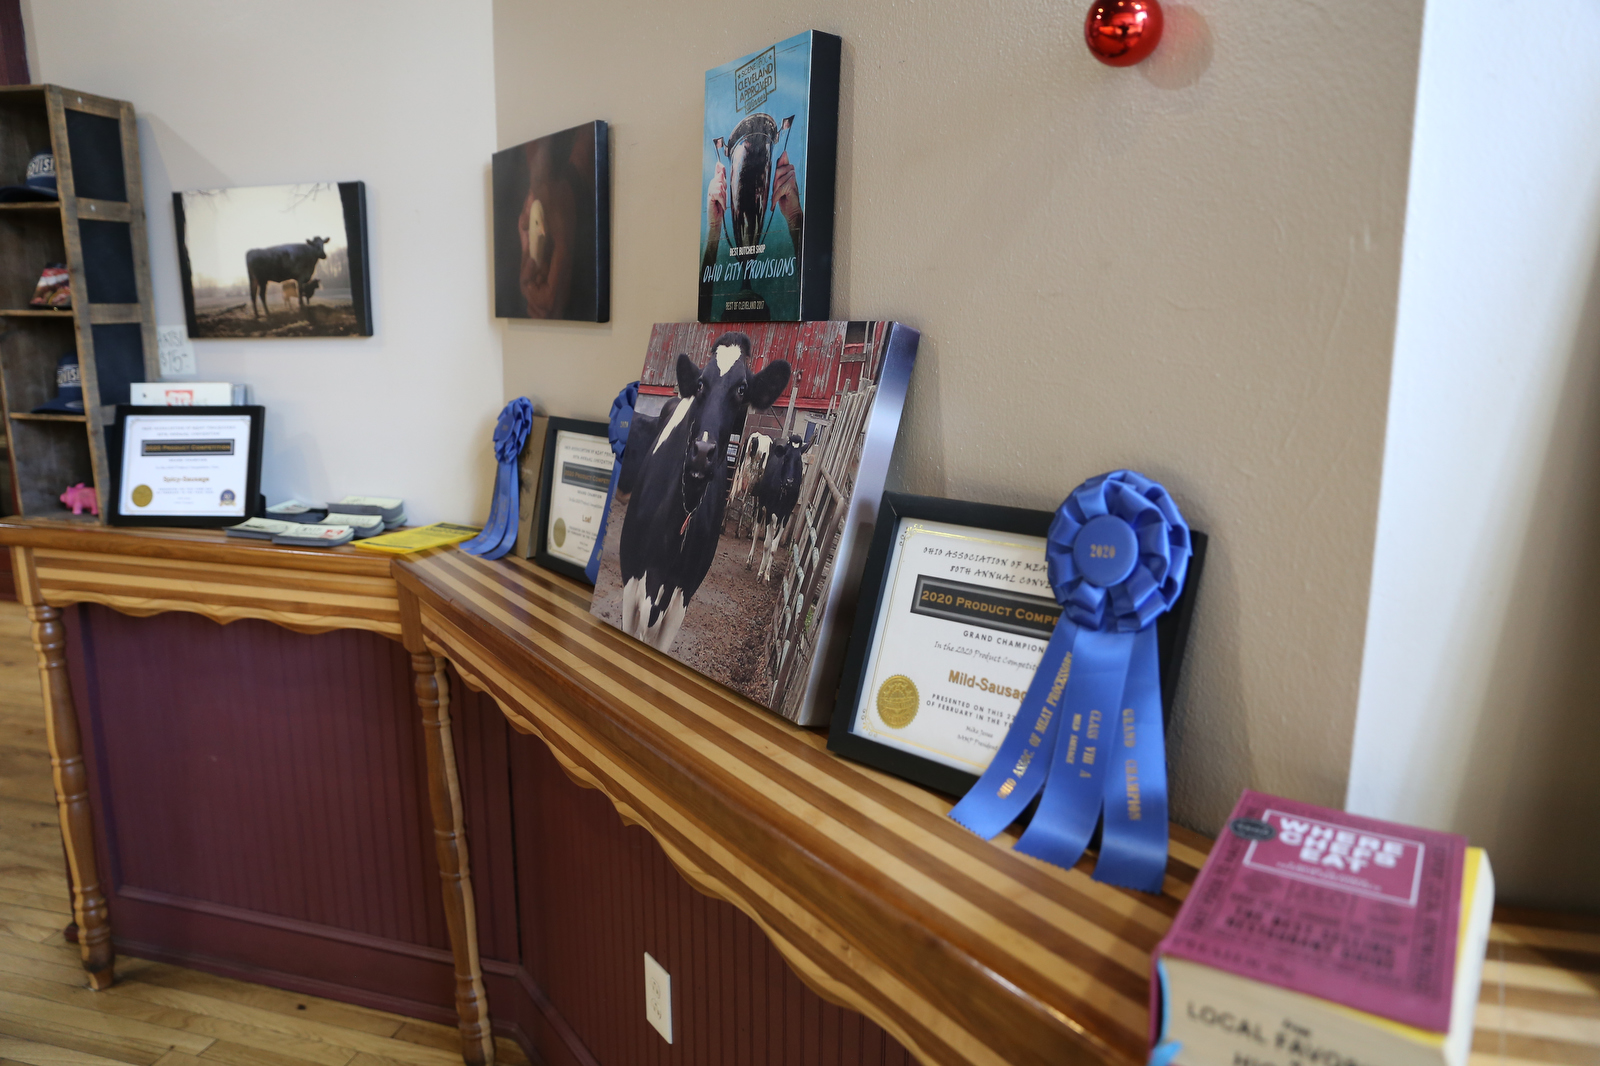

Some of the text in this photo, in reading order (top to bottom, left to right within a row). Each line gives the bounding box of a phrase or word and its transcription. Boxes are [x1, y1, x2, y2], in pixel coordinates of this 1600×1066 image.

[738, 63, 773, 91] CLEVELAND
[740, 76, 772, 103] APPROVED
[729, 244, 766, 256] BEST BUTCHER SHOP
[703, 257, 796, 283] OHIO CITY PROVISIONS
[725, 302, 733, 310] BEST
[923, 547, 1048, 573] OHIO ASSOCIATION OF MEA
[1090, 544, 1116, 559] 2020
[974, 569, 1016, 583] ANNUAL
[1019, 578, 1052, 589] CONVE
[921, 590, 1059, 626] 2020 PRODUCT COMPE
[963, 630, 1045, 654] GRAND CHAMPION
[943, 642, 954, 651] the
[973, 649, 1001, 663] Product
[1002, 656, 1039, 671] Competit
[948, 669, 1028, 704] Mild-Sausag
[932, 693, 970, 709] PRESENTED
[973, 704, 984, 713] ON
[987, 708, 1003, 718] THIS
[938, 703, 973, 718] FEBRUARY
[987, 716, 1000, 725] THE
[1034, 706, 1053, 734] MEAT
[1086, 709, 1102, 739] CLASS
[1029, 732, 1042, 748] OF
[1122, 708, 1142, 821] GRAND CHAMPION
[1279, 817, 1404, 858] WHERE
[1279, 830, 1397, 868] CHEFS
[1300, 847, 1369, 874] EAT
[1186, 1001, 1266, 1044] LOCAL
